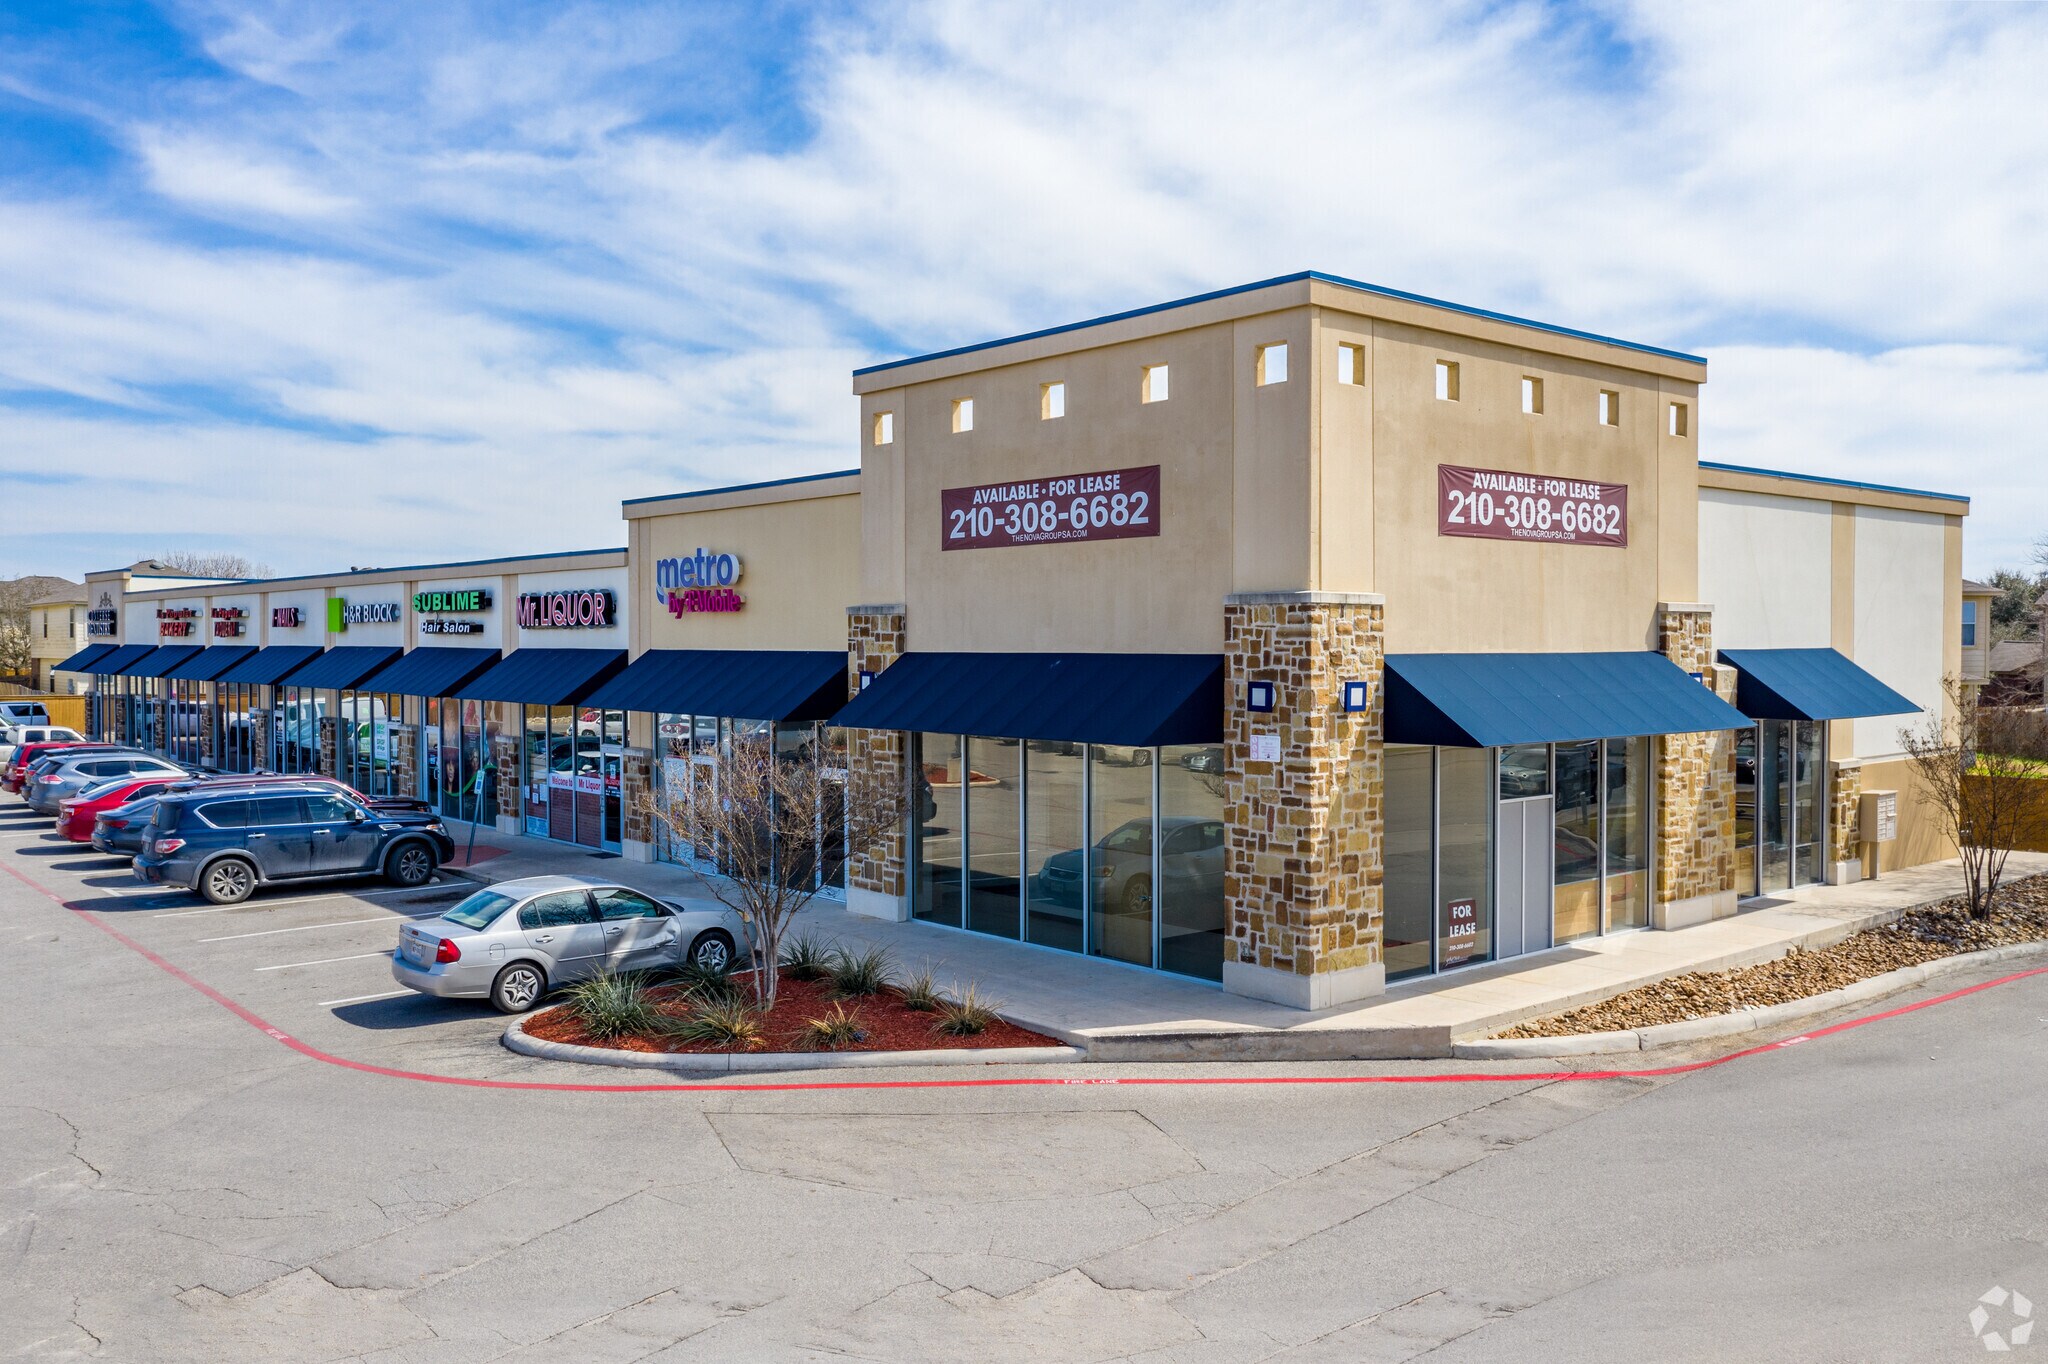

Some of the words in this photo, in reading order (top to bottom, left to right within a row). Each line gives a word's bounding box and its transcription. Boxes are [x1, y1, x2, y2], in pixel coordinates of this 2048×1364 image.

[973, 483, 1039, 505] AVAILABLE
[1049, 479, 1076, 497] FOR
[1080, 474, 1121, 494] LEASE
[1473, 472, 1536, 494] AVAILABLE
[1544, 480, 1566, 497] FOR
[1569, 484, 1600, 500] LEASE
[950, 491, 1149, 539] 210-308-6682
[1447, 490, 1620, 535] 210-308-6682
[1012, 529, 1088, 542] THENOVAGROUPSA.COM
[1511, 528, 1576, 540] THENOVAGROUPSA.COM
[656, 548, 733, 588] metro
[412, 591, 480, 611] SUBLIME
[516, 595, 539, 626] Mr.
[541, 592, 606, 626] LIQUOR
[668, 591, 685, 619] by
[343, 605, 361, 623] H&R
[363, 603, 393, 623] BLOCK
[160, 622, 188, 636] BAKERY
[421, 622, 441, 633] Hair
[443, 622, 470, 633] Salon
[578, 778, 585, 788] Mr
[1452, 904, 1472, 919] FOR
[1449, 923, 1476, 938] LEASE
